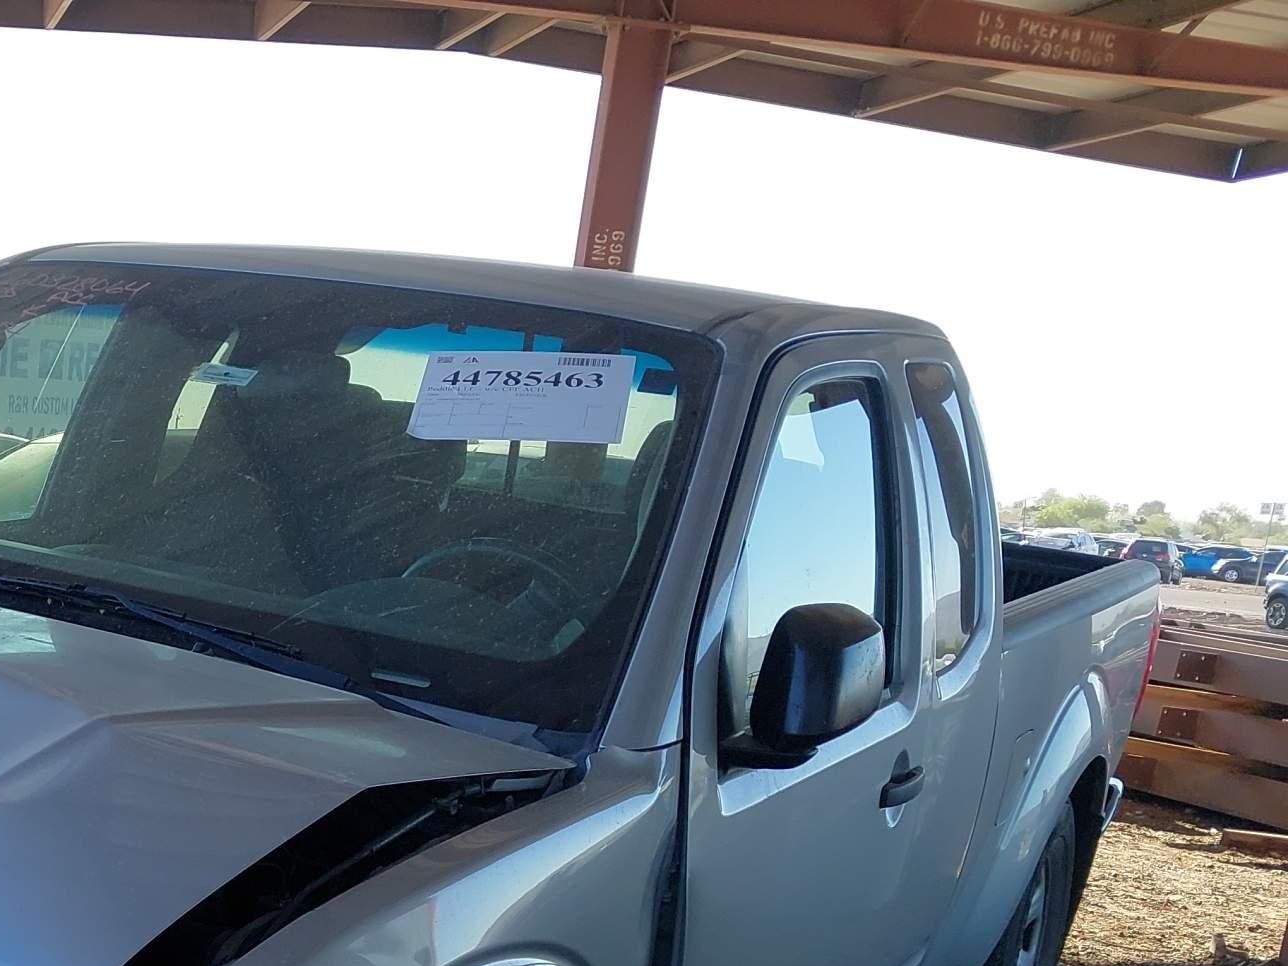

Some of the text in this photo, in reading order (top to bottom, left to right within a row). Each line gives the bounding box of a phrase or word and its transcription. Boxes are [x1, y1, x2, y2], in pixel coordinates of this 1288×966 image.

[591, 228, 609, 261] INC.
[607, 230, 625, 271] 969
[442, 368, 604, 389] 44785463
[8, 394, 29, 415] R&R
[32, 395, 68, 416] CUSTOM
